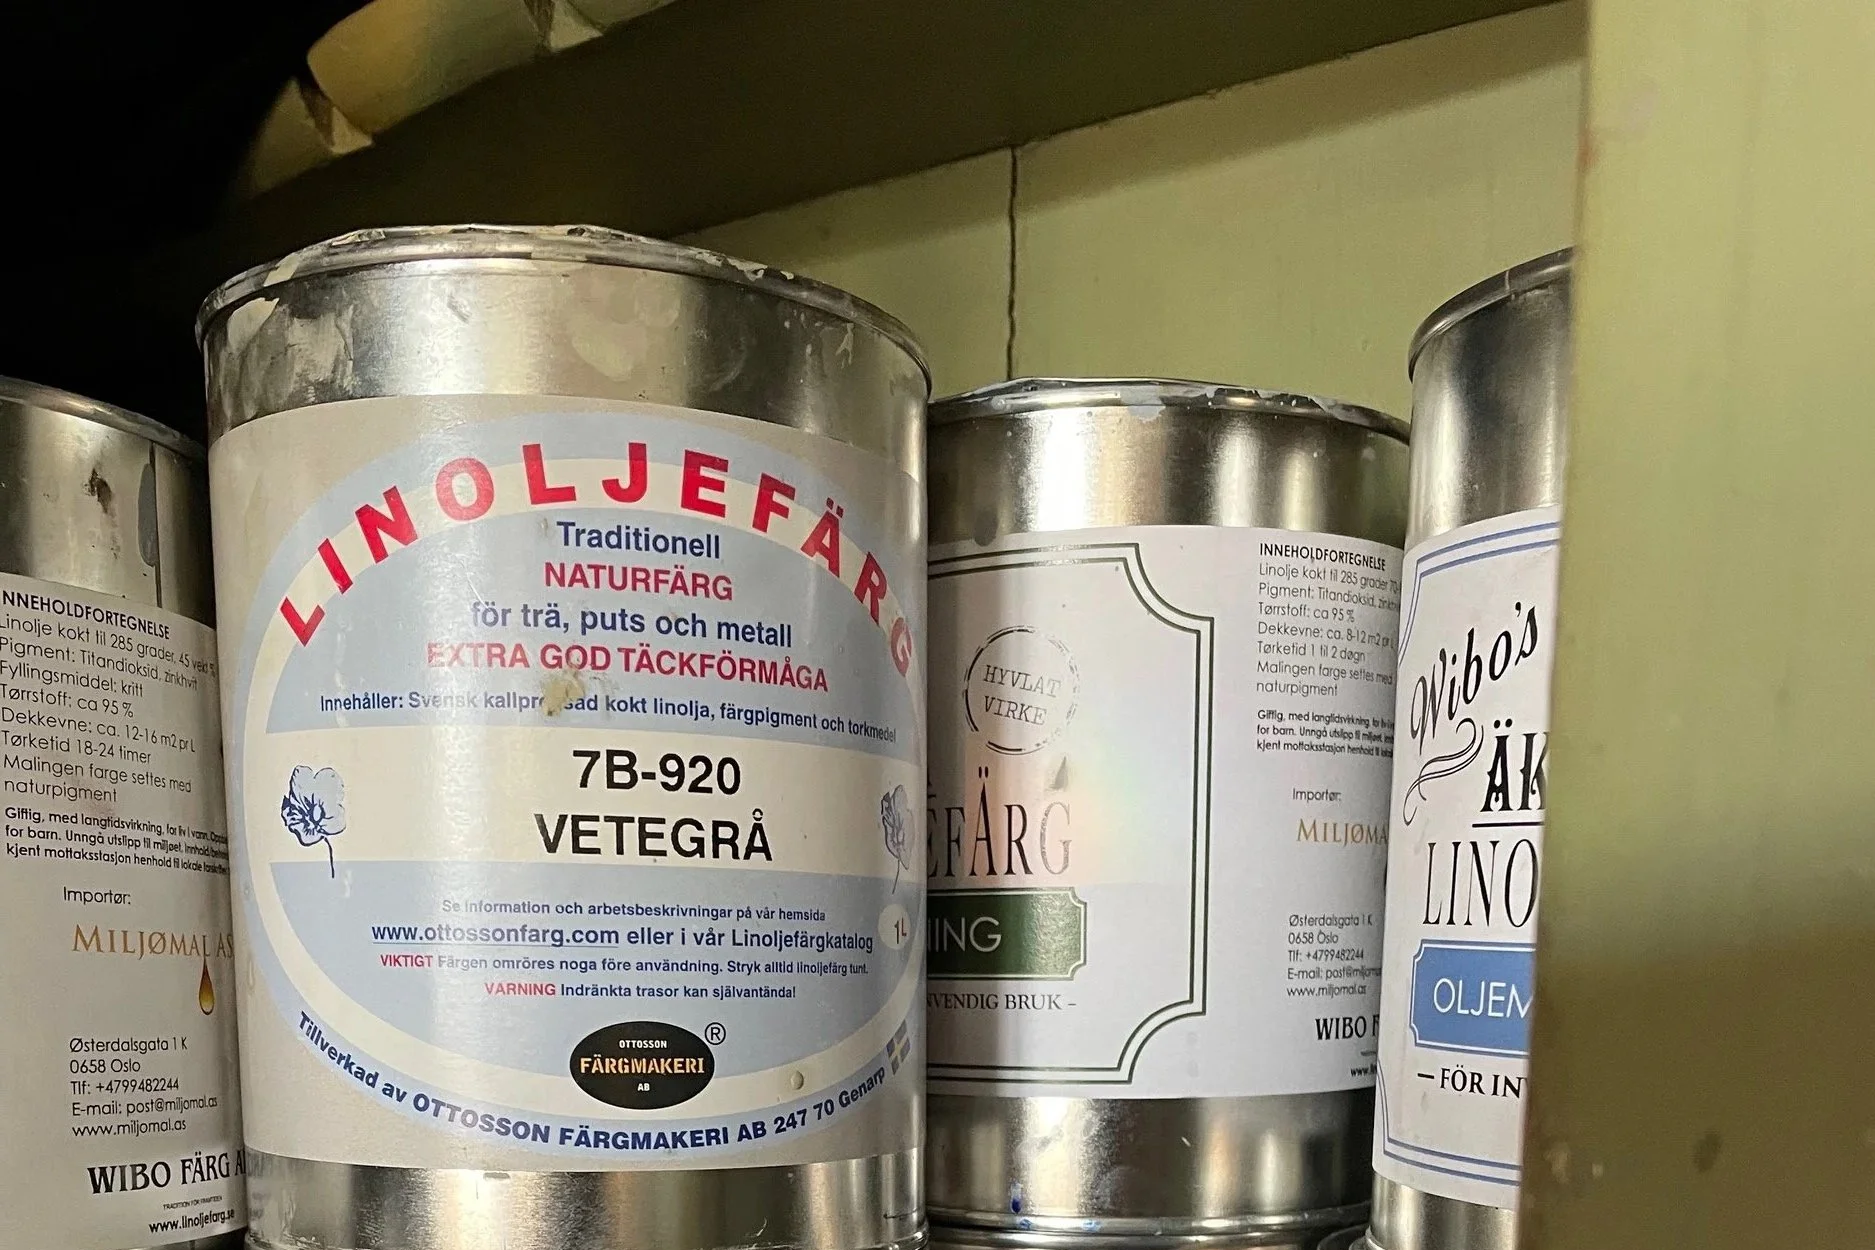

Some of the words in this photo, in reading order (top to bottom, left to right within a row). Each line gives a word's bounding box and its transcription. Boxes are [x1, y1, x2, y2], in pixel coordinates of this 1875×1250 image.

[556, 520, 720, 559] Traditionell
[280, 442, 912, 678] LINOLJEFÄRG
[1260, 543, 1385, 571] INNEHOLDFORTEGNELSE
[545, 561, 733, 600] NATURFÄRG
[1259, 563, 1299, 579] Linolje
[1302, 566, 1326, 579] kokt
[1259, 583, 1314, 599] Pigment:
[2, 590, 171, 640] NNEHOLDFORTEGNELSE
[472, 602, 511, 627] för
[521, 603, 569, 633] trä,
[581, 609, 645, 635] puts
[655, 614, 706, 637] och
[717, 623, 792, 648] metall
[1332, 608, 1344, 621] 95
[58, 621, 90, 643] kokt
[95, 627, 106, 646] til
[111, 633, 133, 651] 285
[1258, 621, 1323, 639] Dekkevne:
[0, 636, 75, 663] Pigment:
[1257, 641, 1306, 656] Tørketid
[0, 661, 117, 694] Fyllingsmiddel:
[121, 678, 143, 697] kritt
[427, 642, 530, 668] EXTRA
[540, 643, 612, 670] GOD
[617, 645, 828, 692] TÄCKFÖRMÅGA
[1257, 661, 1315, 677] Malingen
[983, 665, 1062, 699] HYVLAT
[1257, 680, 1338, 697] naturpigment
[0, 684, 72, 708] Tørrstoff:
[77, 698, 98, 711] ca
[103, 700, 119, 716] 95
[984, 696, 1047, 726] VIRKE
[1, 707, 92, 734] Dekkevne:
[125, 725, 157, 745] 12-16
[321, 694, 403, 712] Innehåller:
[408, 692, 478, 708] Svensk
[605, 696, 647, 714] kokt
[653, 698, 715, 721] linolja,
[720, 703, 817, 728] färgpigment
[821, 715, 844, 733] och
[849, 719, 896, 743] torkmedel
[1, 731, 69, 753] Tørketid
[77, 739, 114, 758] 18-24
[119, 746, 151, 765] timer
[3, 754, 84, 779] Malingen
[89, 764, 127, 784] farge
[131, 770, 166, 789] settes
[169, 777, 191, 793] med
[573, 749, 742, 796] 7B-920
[1480, 718, 1549, 813] ÄK
[4, 779, 116, 802] naturpigment
[49, 811, 78, 824] med
[6, 825, 23, 837] for
[27, 826, 61, 841] barn.
[65, 829, 104, 847] Unngå
[534, 809, 773, 862] VETEGRÅ
[1296, 819, 1389, 848] MILJØMA
[6, 843, 41, 859] kjent
[63, 886, 131, 905] Importør:
[1422, 838, 1539, 928] LINO
[442, 900, 460, 913] Se
[555, 904, 583, 915] och
[588, 903, 733, 922] arbetsbeskrivningar
[737, 908, 752, 921] på
[756, 907, 775, 919] vår
[779, 909, 825, 921] hemsida
[372, 924, 619, 947] www.ottossonfarg.com
[627, 927, 674, 946] eller
[681, 929, 686, 945] i
[693, 927, 724, 946] vår
[732, 929, 872, 952] Linoljefärgkatalog
[1288, 932, 1314, 945] 0658
[380, 955, 433, 967] VIKTIGT
[438, 956, 487, 971] Färgen
[492, 957, 555, 970] omröres
[560, 960, 597, 973] noga
[602, 959, 631, 971] före
[636, 960, 723, 975] användning.
[727, 961, 761, 975] Stryk
[765, 961, 793, 973] alltid
[797, 962, 847, 976] linoljefärg
[484, 983, 555, 996] VARNING
[561, 984, 631, 997] Indränkta
[636, 987, 679, 997] trasor
[684, 986, 708, 997] kan
[713, 987, 796, 1000] självantända!
[1005, 994, 1062, 1010] BRUK
[1316, 1016, 1367, 1041] WIBO
[69, 1037, 168, 1054] Østerdalsgata
[619, 1040, 667, 1048] OTTOSSON
[70, 1060, 105, 1073] 0658
[111, 1059, 141, 1073] Oslo
[580, 1054, 704, 1074] FÄRGMAKERI
[95, 1078, 179, 1094] +4799482244
[298, 1010, 378, 1089] Tillverkad
[382, 1081, 407, 1103] av
[413, 1092, 550, 1144] OTTOSSON
[559, 1125, 729, 1149] FÄRGMAKERI
[737, 1125, 767, 1143] AB
[774, 1109, 807, 1134] 247
[813, 1098, 834, 1121] 70
[838, 1066, 885, 1108] Genarp
[638, 1083, 650, 1091] AB
[1440, 1064, 1485, 1096] FÖR
[72, 1102, 122, 1116] E-mail:
[87, 1161, 171, 1194] WIBO
[181, 1151, 229, 1186] FÄRG
